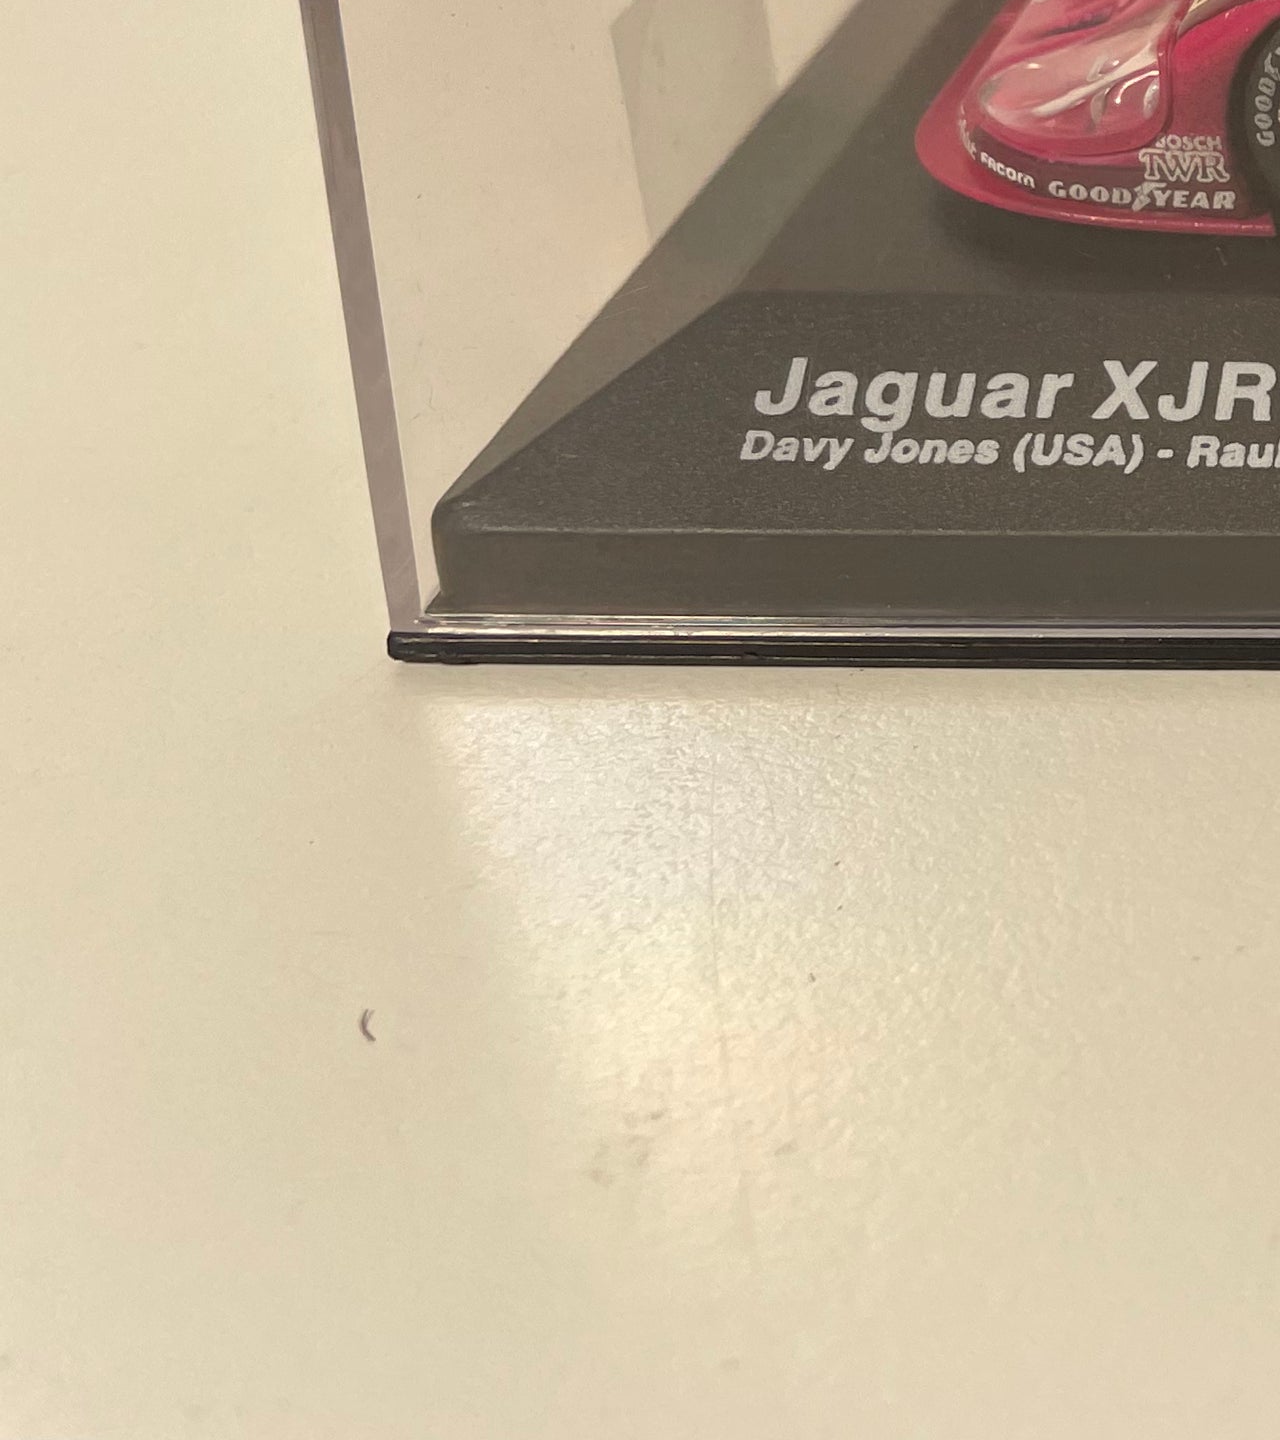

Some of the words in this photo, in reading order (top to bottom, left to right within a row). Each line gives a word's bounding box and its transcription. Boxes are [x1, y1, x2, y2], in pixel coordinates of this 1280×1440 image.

[1138, 147, 1232, 183] TWR
[1048, 181, 1238, 211] GOODYEAR
[752, 355, 1076, 433] Jaguar
[739, 429, 855, 471] Davy
[863, 432, 1001, 466] Jones
[1012, 432, 1146, 474] (USA)
